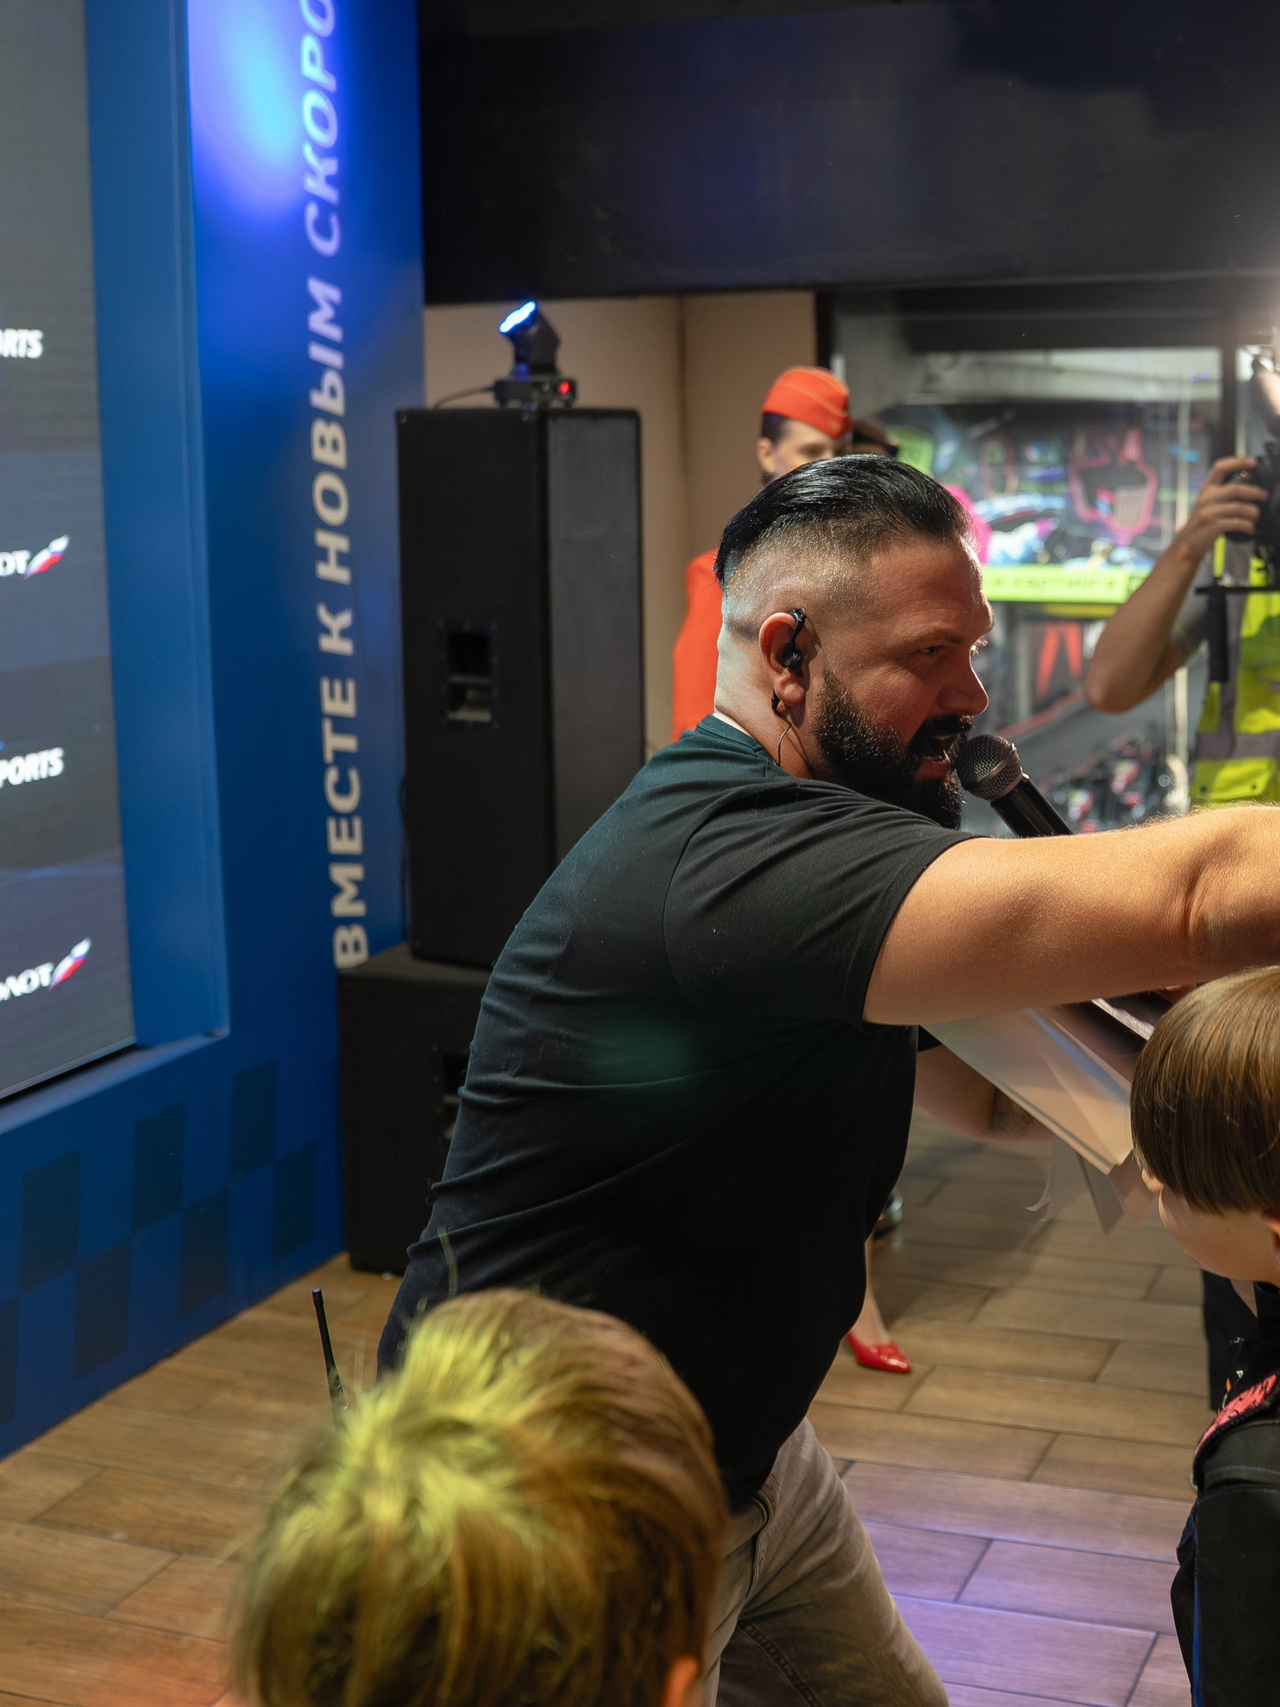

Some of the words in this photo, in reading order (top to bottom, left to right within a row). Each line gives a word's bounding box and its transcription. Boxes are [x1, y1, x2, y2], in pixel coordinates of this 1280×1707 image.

[0, 328, 44, 359] RTS
[306, 275, 352, 586] НОВЫМ
[317, 603, 354, 656] К
[320, 676, 370, 969] ВМЕСТЕ
